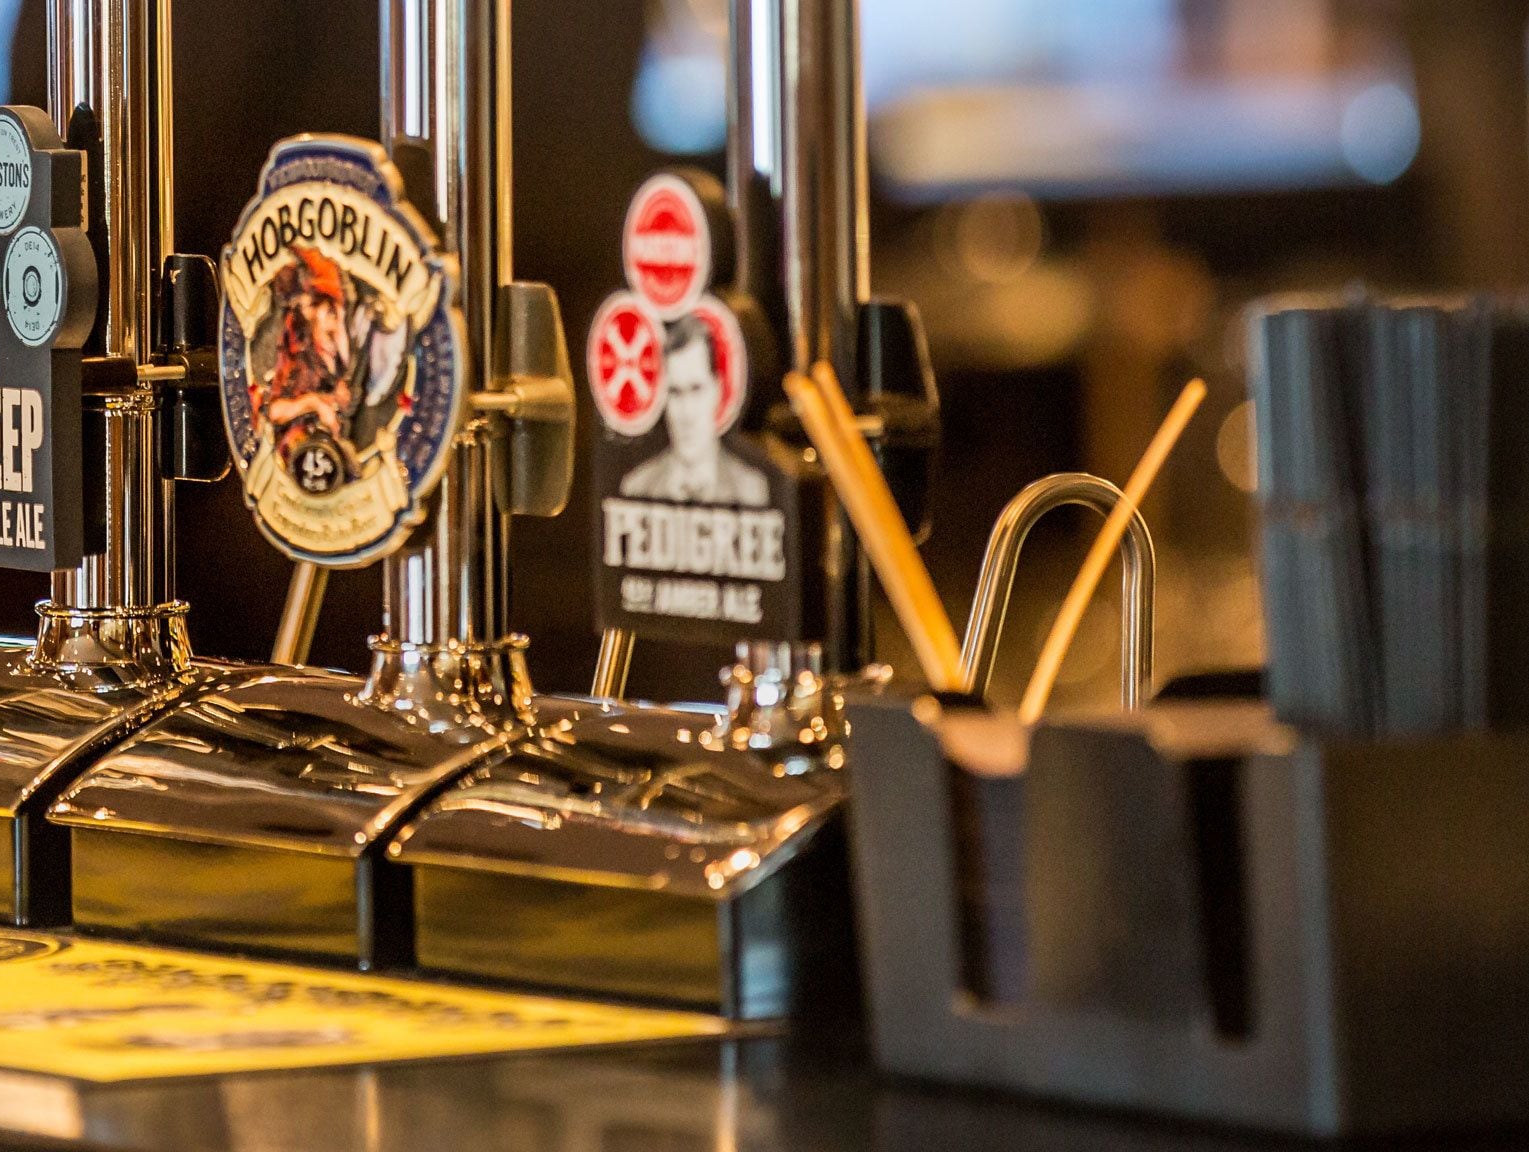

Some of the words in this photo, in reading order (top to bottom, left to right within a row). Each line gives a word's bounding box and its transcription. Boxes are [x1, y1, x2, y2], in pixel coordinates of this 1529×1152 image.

[242, 197, 412, 290] HOBGOBLIN
[15, 502, 46, 550] ALE
[602, 499, 785, 581] PEDIGREE
